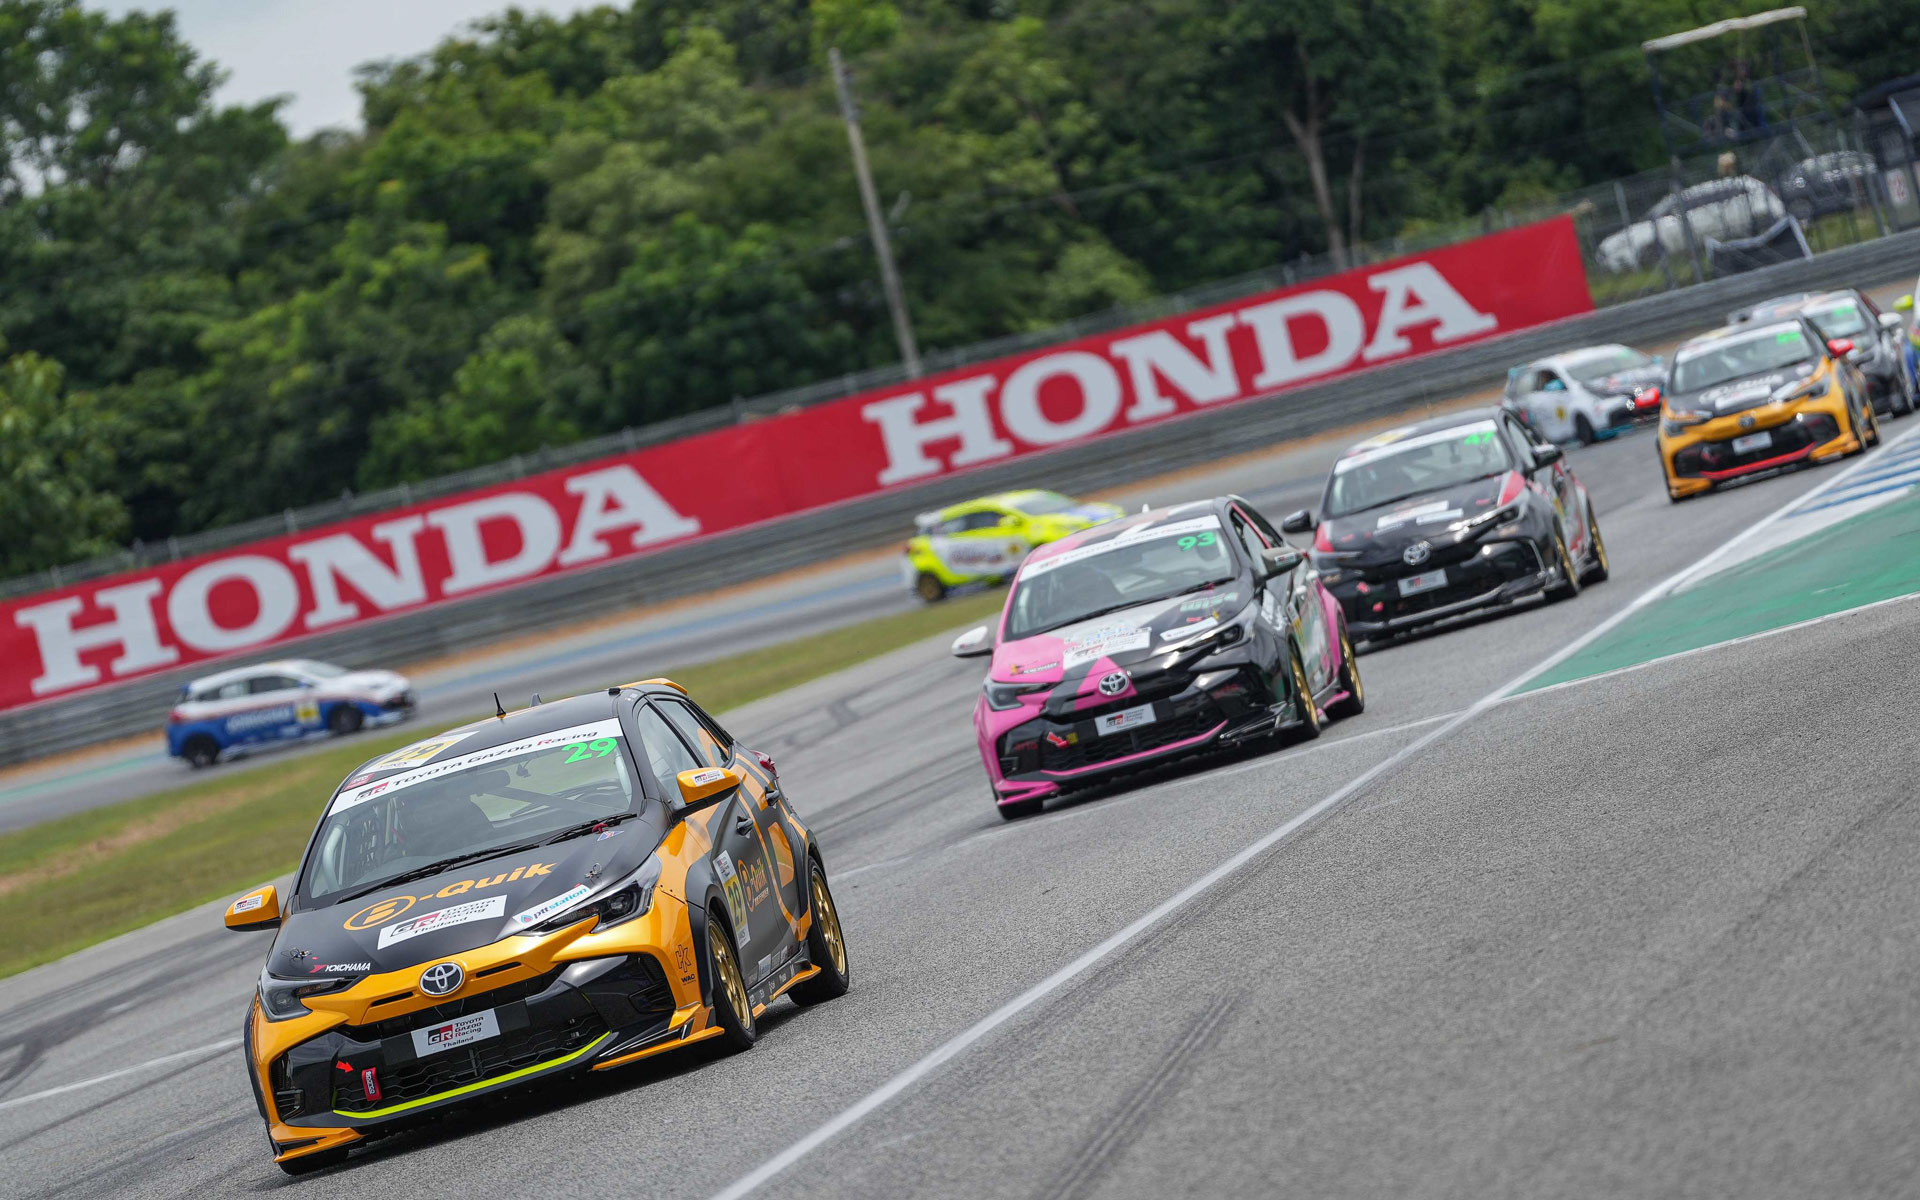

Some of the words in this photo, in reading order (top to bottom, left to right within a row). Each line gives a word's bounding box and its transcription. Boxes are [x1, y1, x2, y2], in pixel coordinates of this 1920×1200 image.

[862, 262, 1498, 485] HONDA
[1177, 531, 1217, 551] 93
[15, 464, 700, 696] HONDA
[393, 761, 462, 786] TOYOTA
[467, 742, 533, 764] GAZOO
[536, 731, 599, 746] Racing
[561, 737, 619, 764] 29
[343, 862, 558, 931] B-Quik
[390, 911, 441, 938] GR
[454, 1022, 482, 1033] GAZOO
[455, 1016, 484, 1028] TOYOTA
[455, 1027, 482, 1038] Racing
[427, 1024, 453, 1046] GR
[442, 1036, 474, 1048] Thailand
